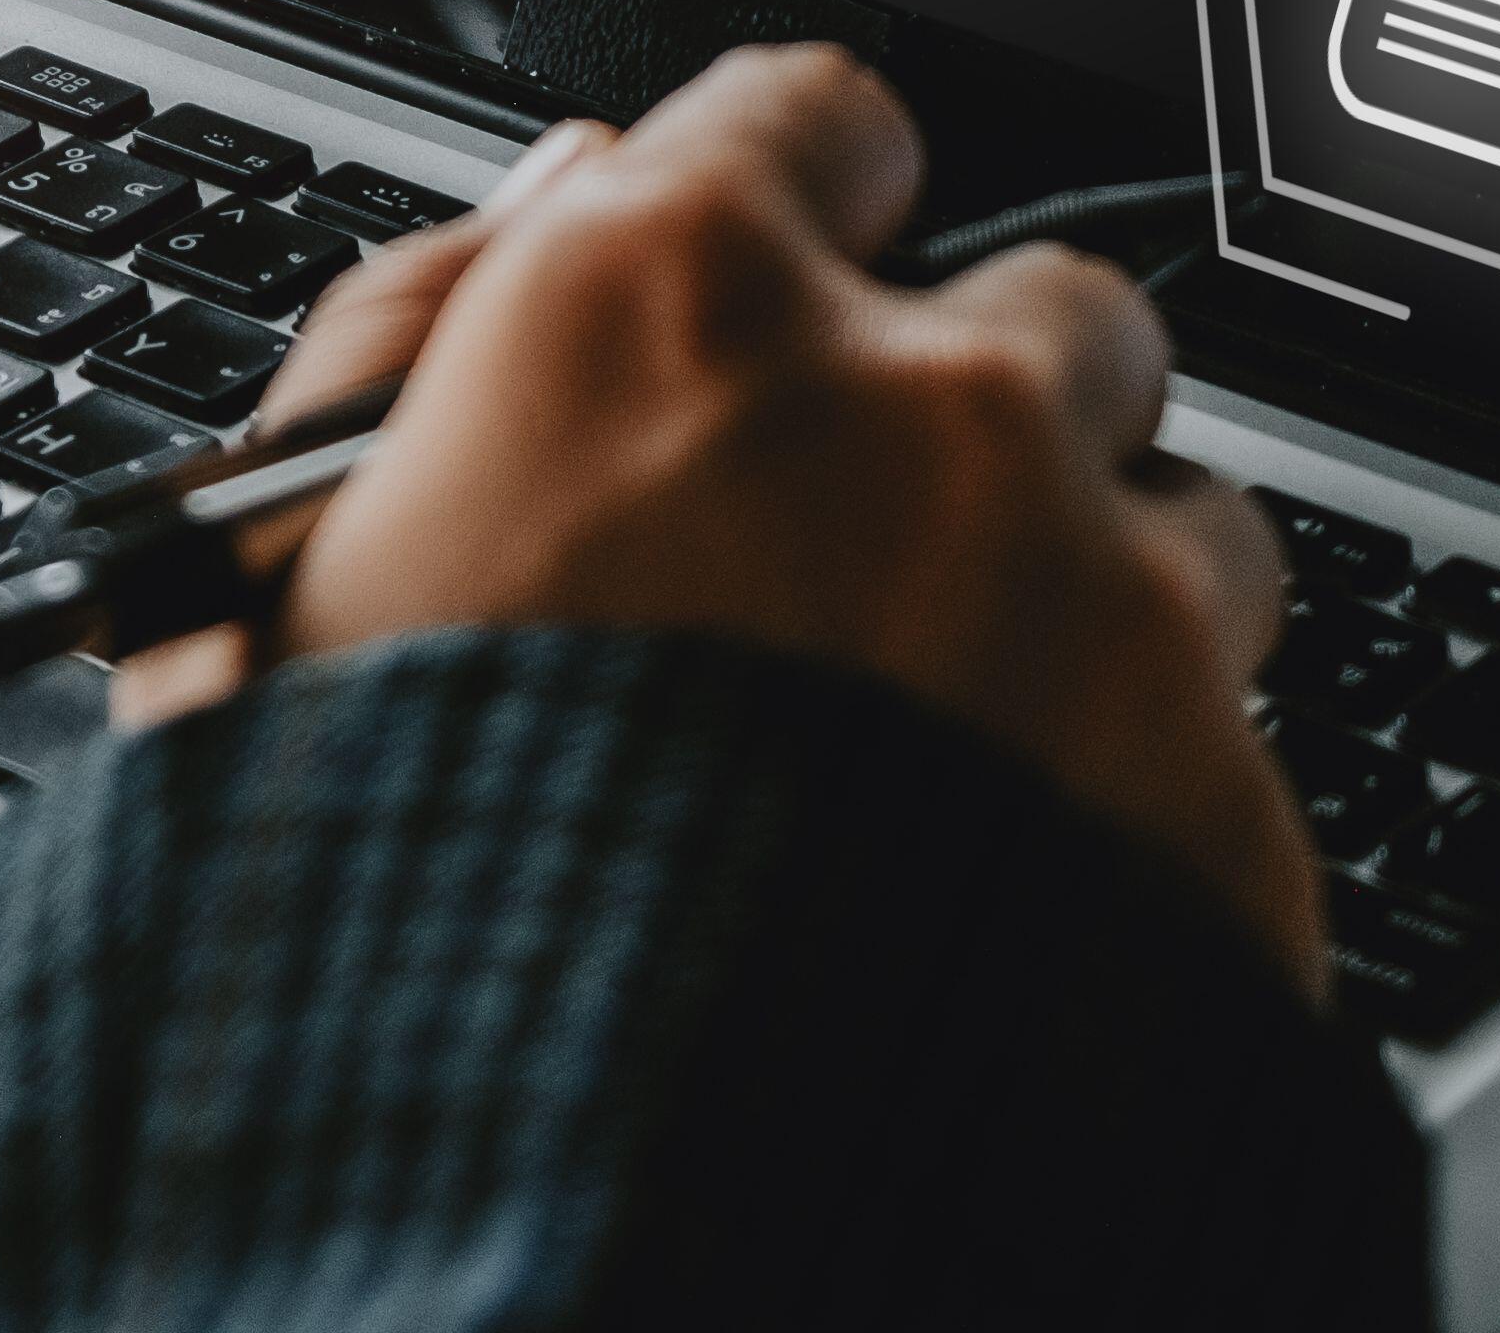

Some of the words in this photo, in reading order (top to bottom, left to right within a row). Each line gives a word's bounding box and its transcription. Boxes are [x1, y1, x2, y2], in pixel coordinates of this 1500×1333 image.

[78, 97, 104, 110] F4
[56, 147, 97, 173] %
[243, 155, 270, 168] F5
[7, 171, 51, 190] 5
[168, 233, 204, 250] 6
[124, 333, 169, 357] Y
[17, 424, 77, 455] H
